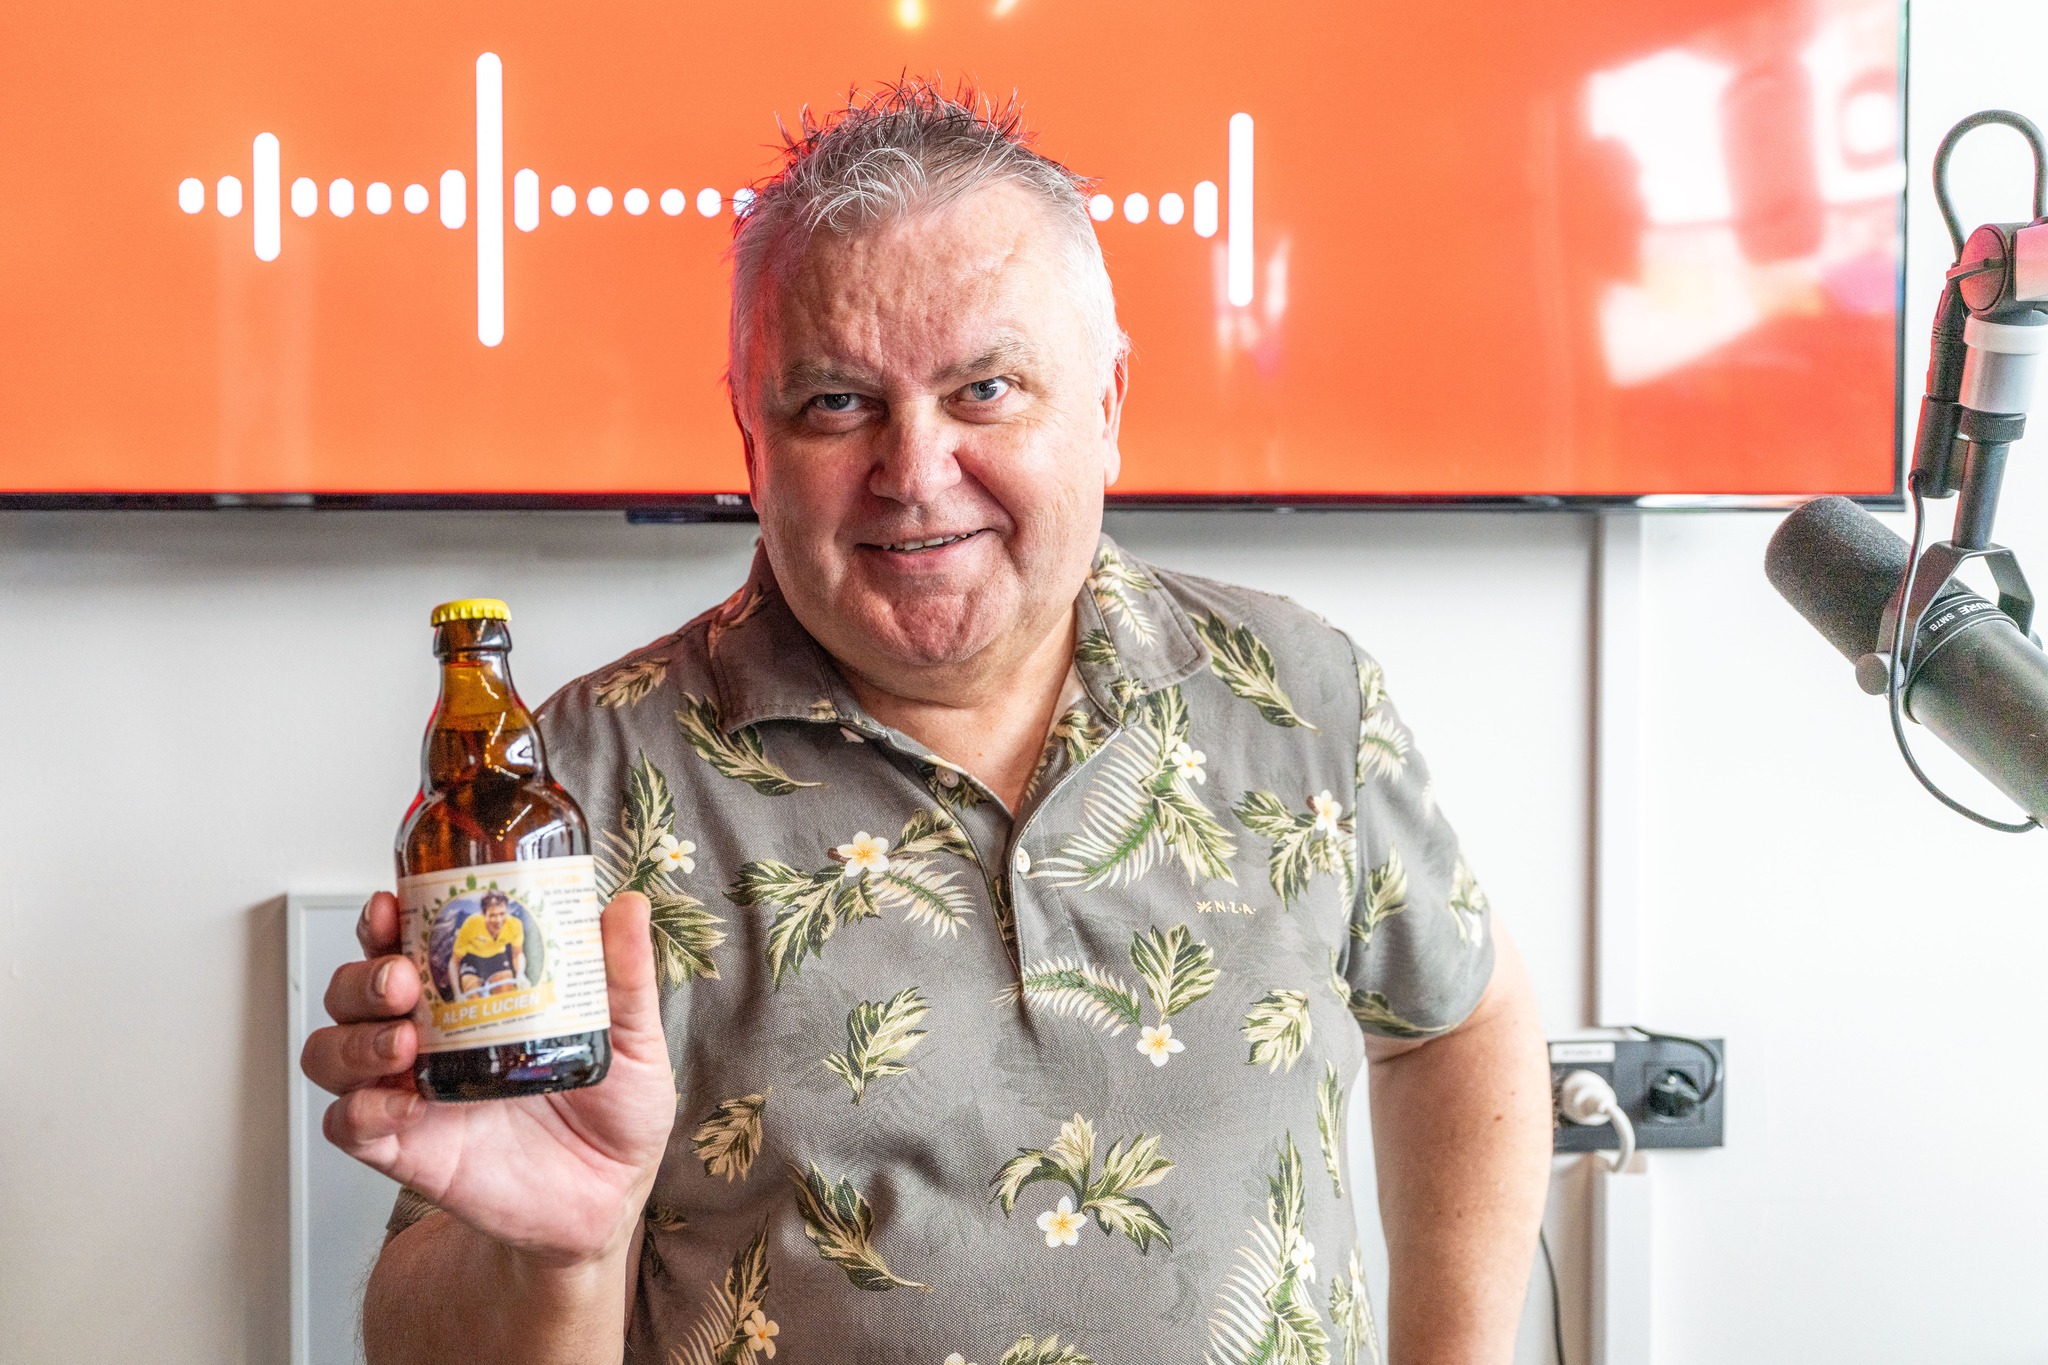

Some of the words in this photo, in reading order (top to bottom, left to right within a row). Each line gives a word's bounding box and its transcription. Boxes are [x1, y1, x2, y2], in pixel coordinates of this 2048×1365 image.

[1929, 612, 1956, 632] SM7B
[443, 1005, 478, 1025] ALPE
[482, 992, 540, 1016] LUCIEN
